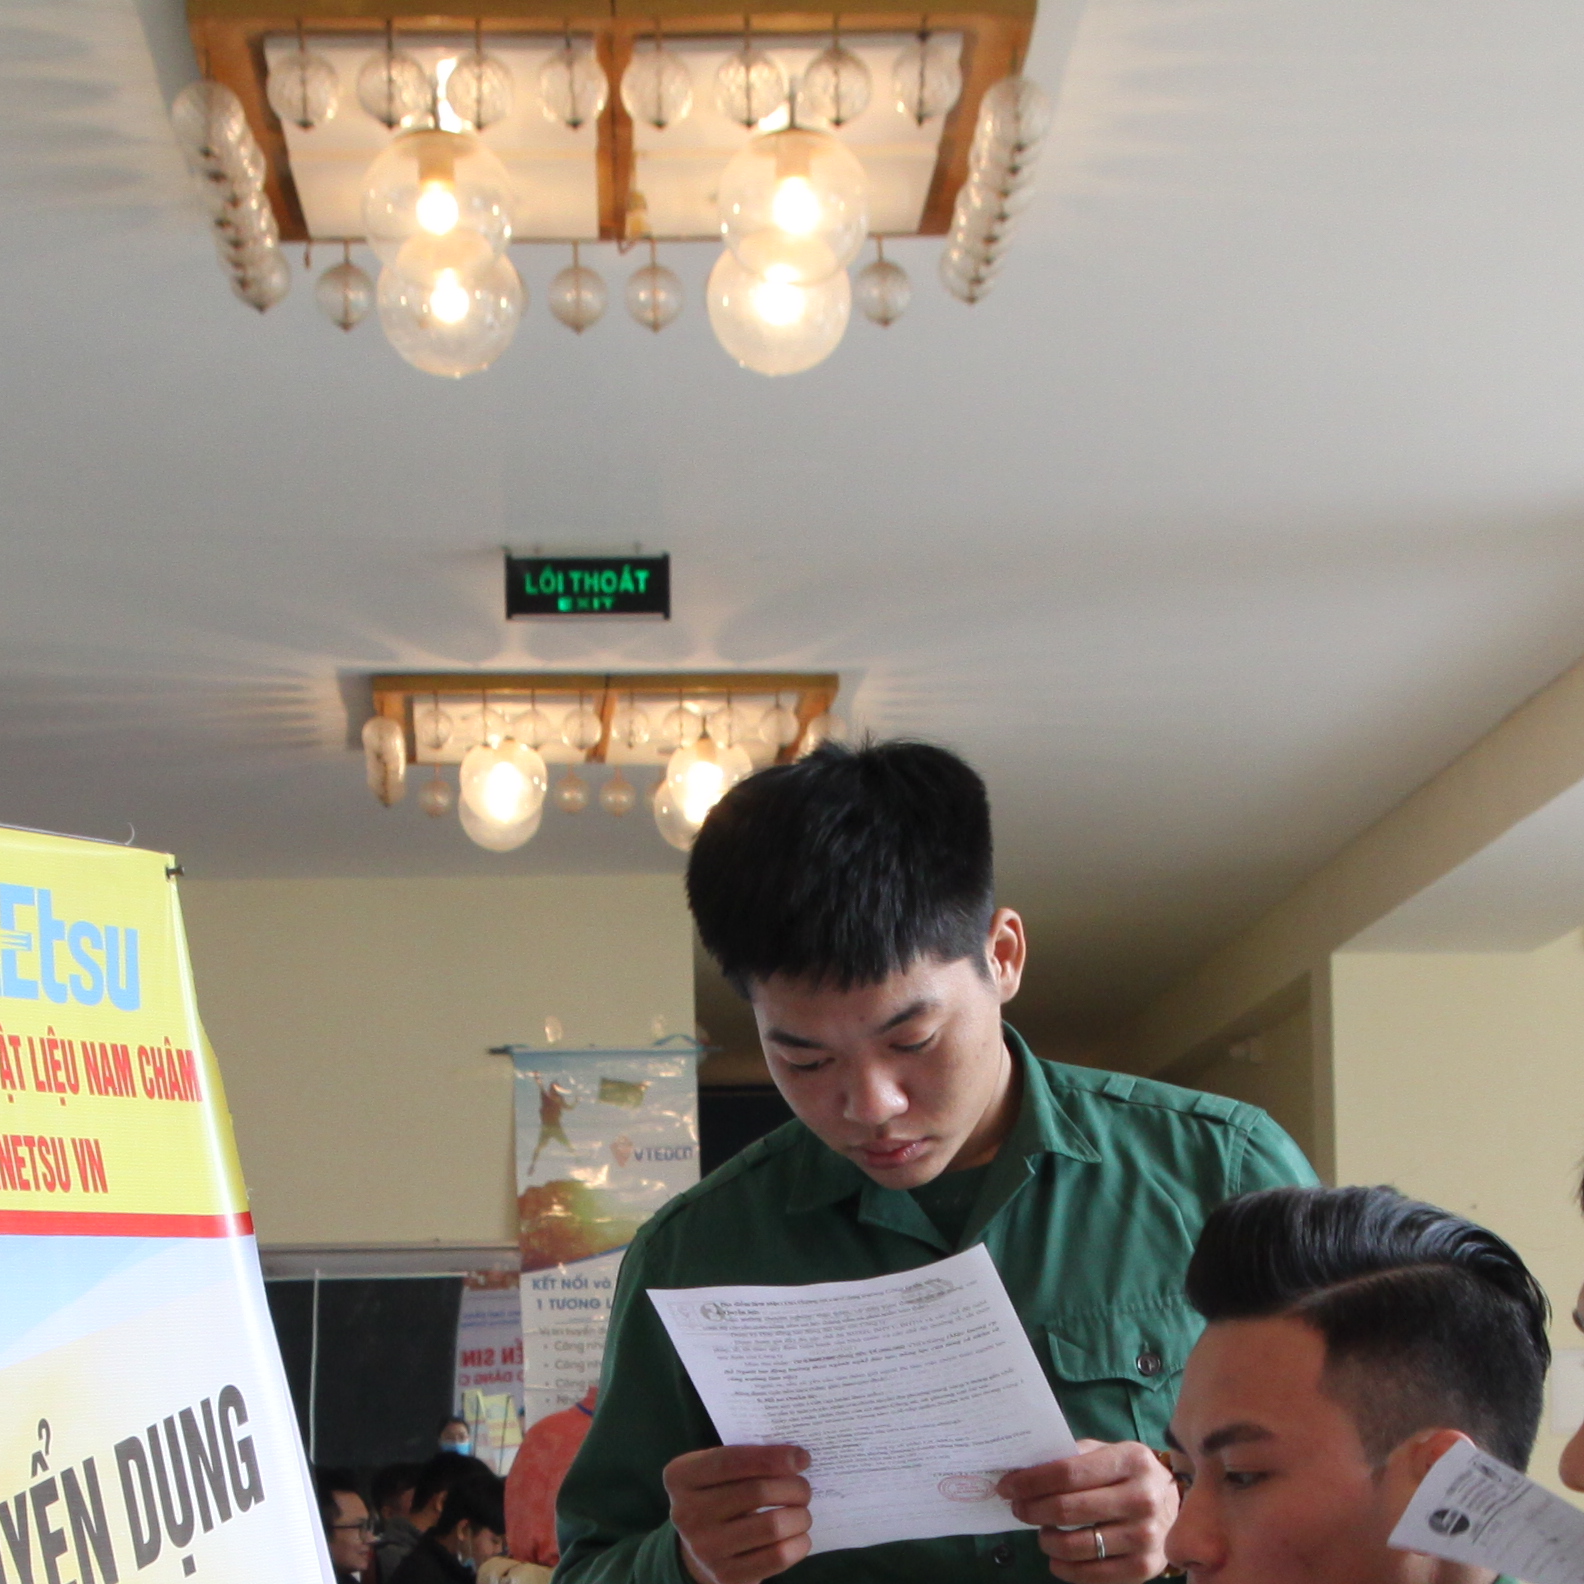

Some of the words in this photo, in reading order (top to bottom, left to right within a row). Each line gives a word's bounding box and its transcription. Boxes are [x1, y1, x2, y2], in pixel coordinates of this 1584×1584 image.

[27, 1025, 80, 1106] LIỆU
[80, 1040, 138, 1098] NAM
[137, 1036, 203, 1102] CHÂM
[70, 1137, 109, 1194] VN
[113, 1384, 265, 1578] DỤNG
